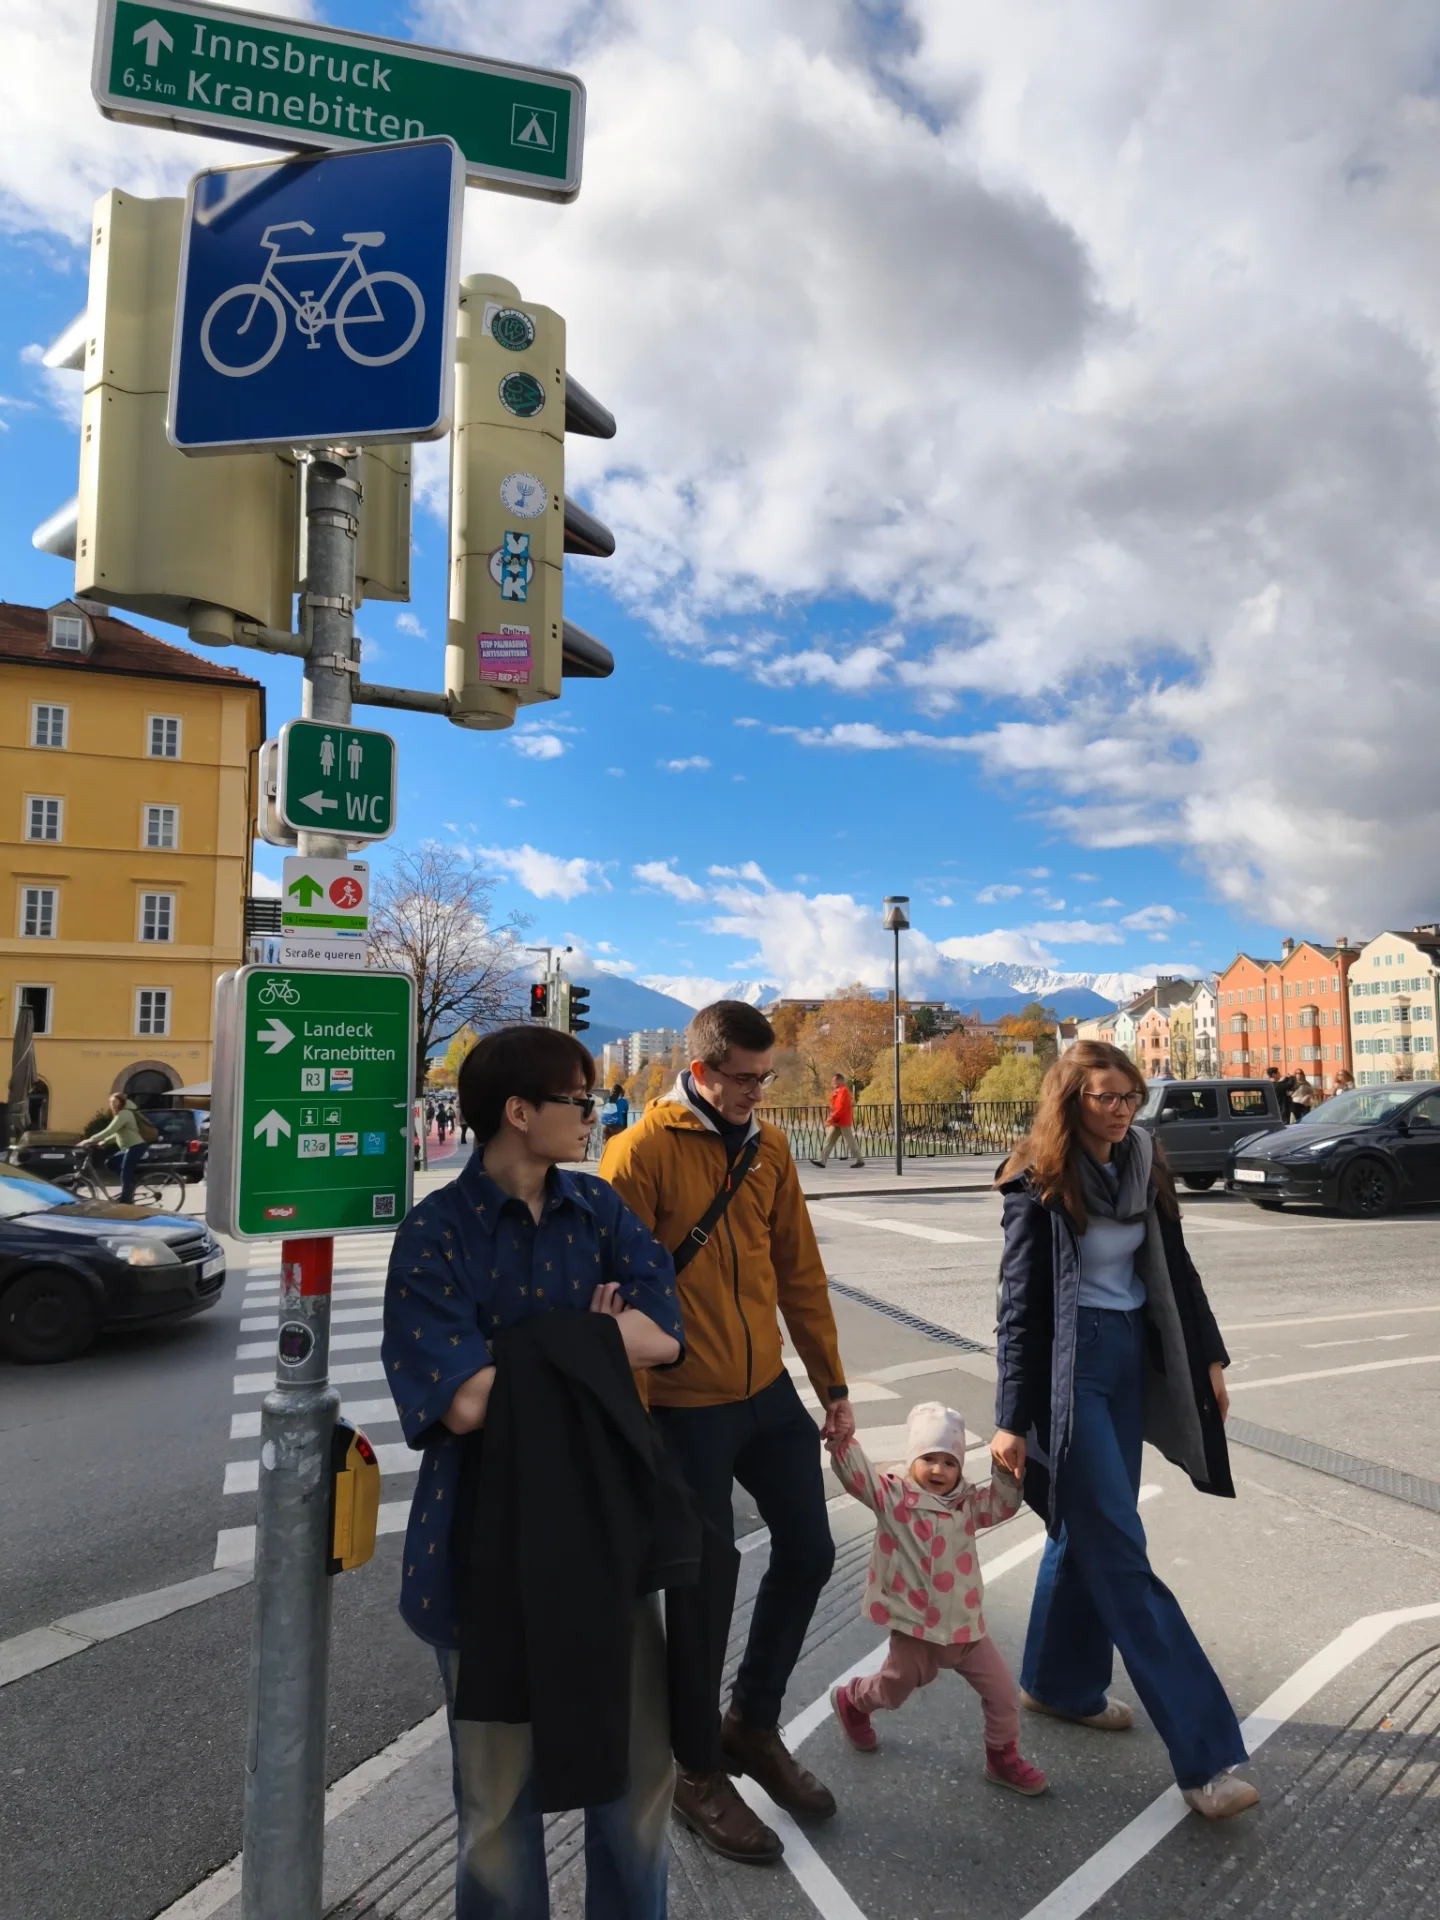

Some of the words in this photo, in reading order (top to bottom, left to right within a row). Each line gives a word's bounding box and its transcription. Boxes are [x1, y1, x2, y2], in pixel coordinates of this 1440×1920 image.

[191, 24, 393, 92] Innsbruck
[123, 67, 152, 93] 6,5
[154, 78, 176, 95] km
[186, 69, 426, 140] Kranebitten
[480, 640, 493, 649] STOP
[498, 672, 512, 682] RKP
[346, 792, 384, 824] WC
[285, 947, 321, 959] Straße
[324, 951, 361, 962] queren
[303, 1021, 373, 1038] Landeck
[303, 1045, 396, 1061] Kranebitten
[306, 1073, 321, 1087] R3
[303, 1139, 326, 1153] R3a
